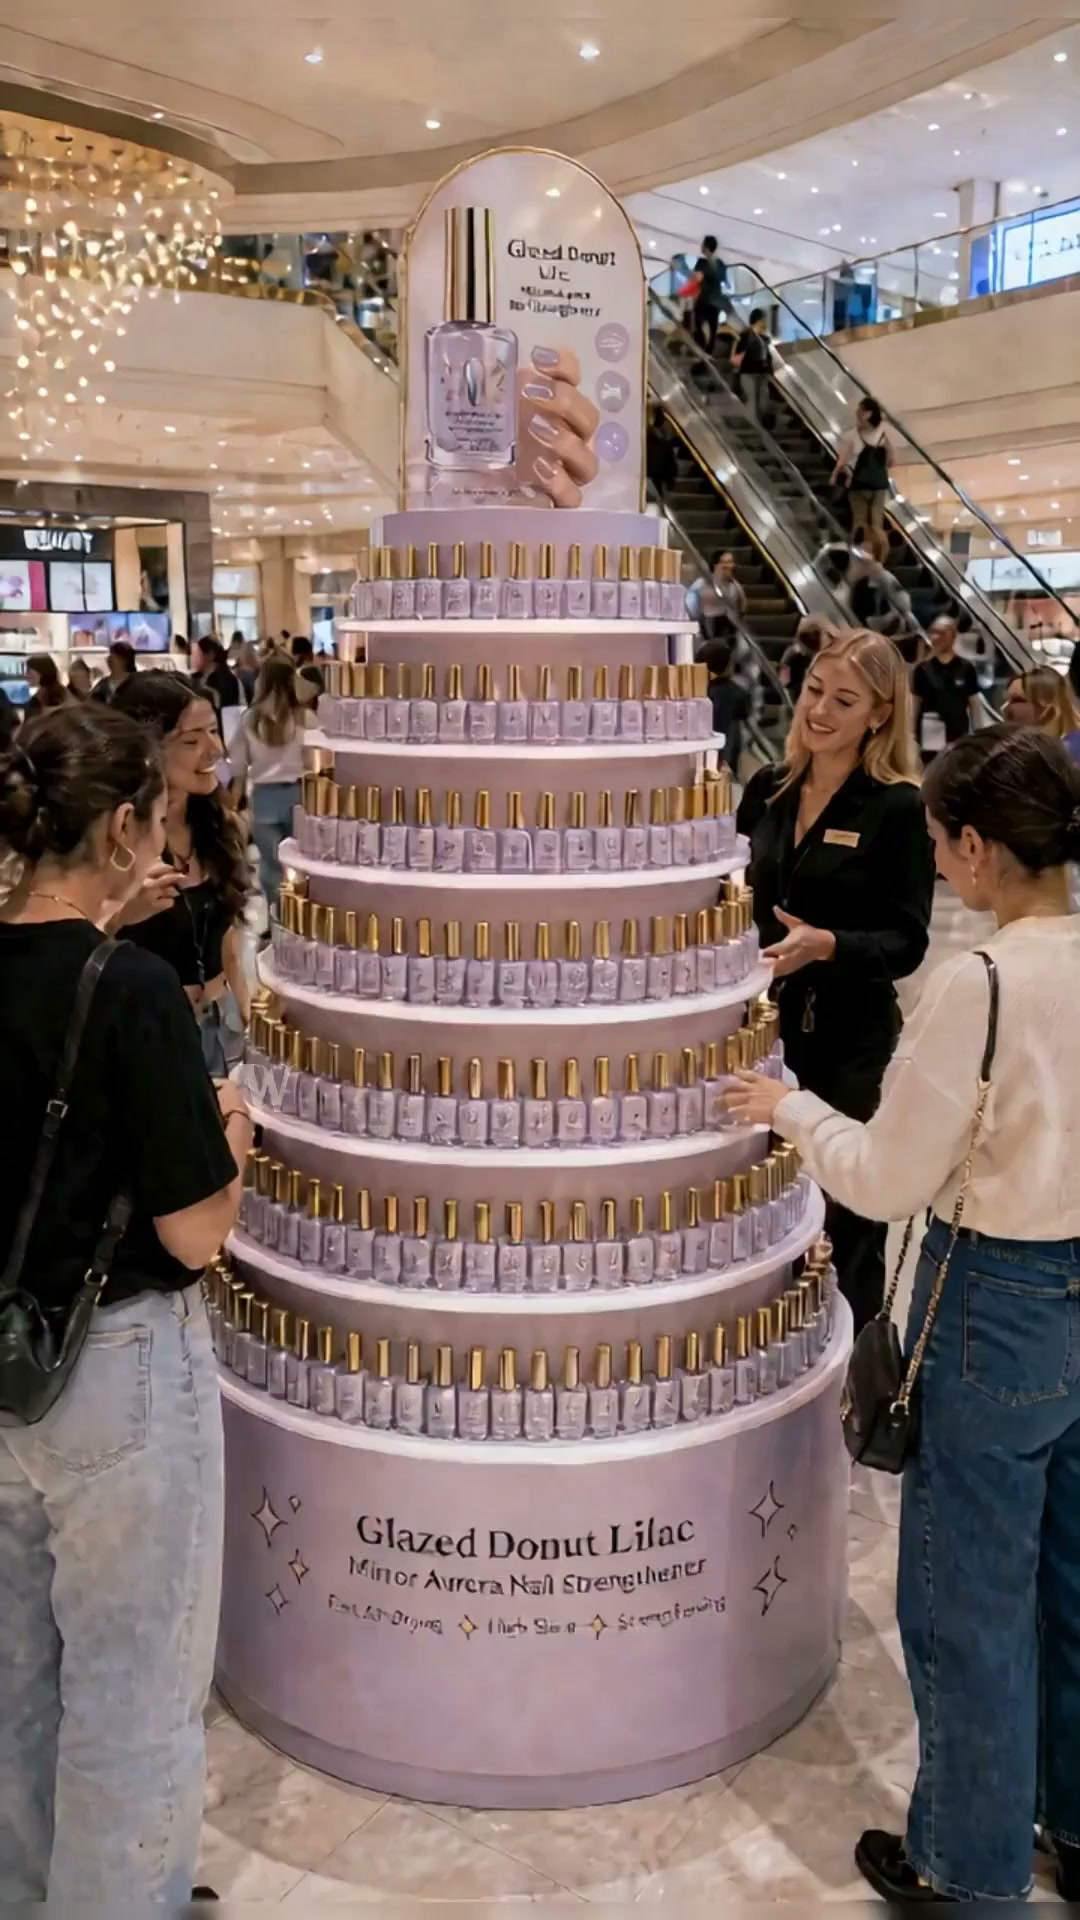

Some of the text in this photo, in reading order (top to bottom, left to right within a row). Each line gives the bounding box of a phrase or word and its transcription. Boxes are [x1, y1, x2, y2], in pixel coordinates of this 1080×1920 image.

[356, 1515, 696, 1560] Glazed Donut Lilac
